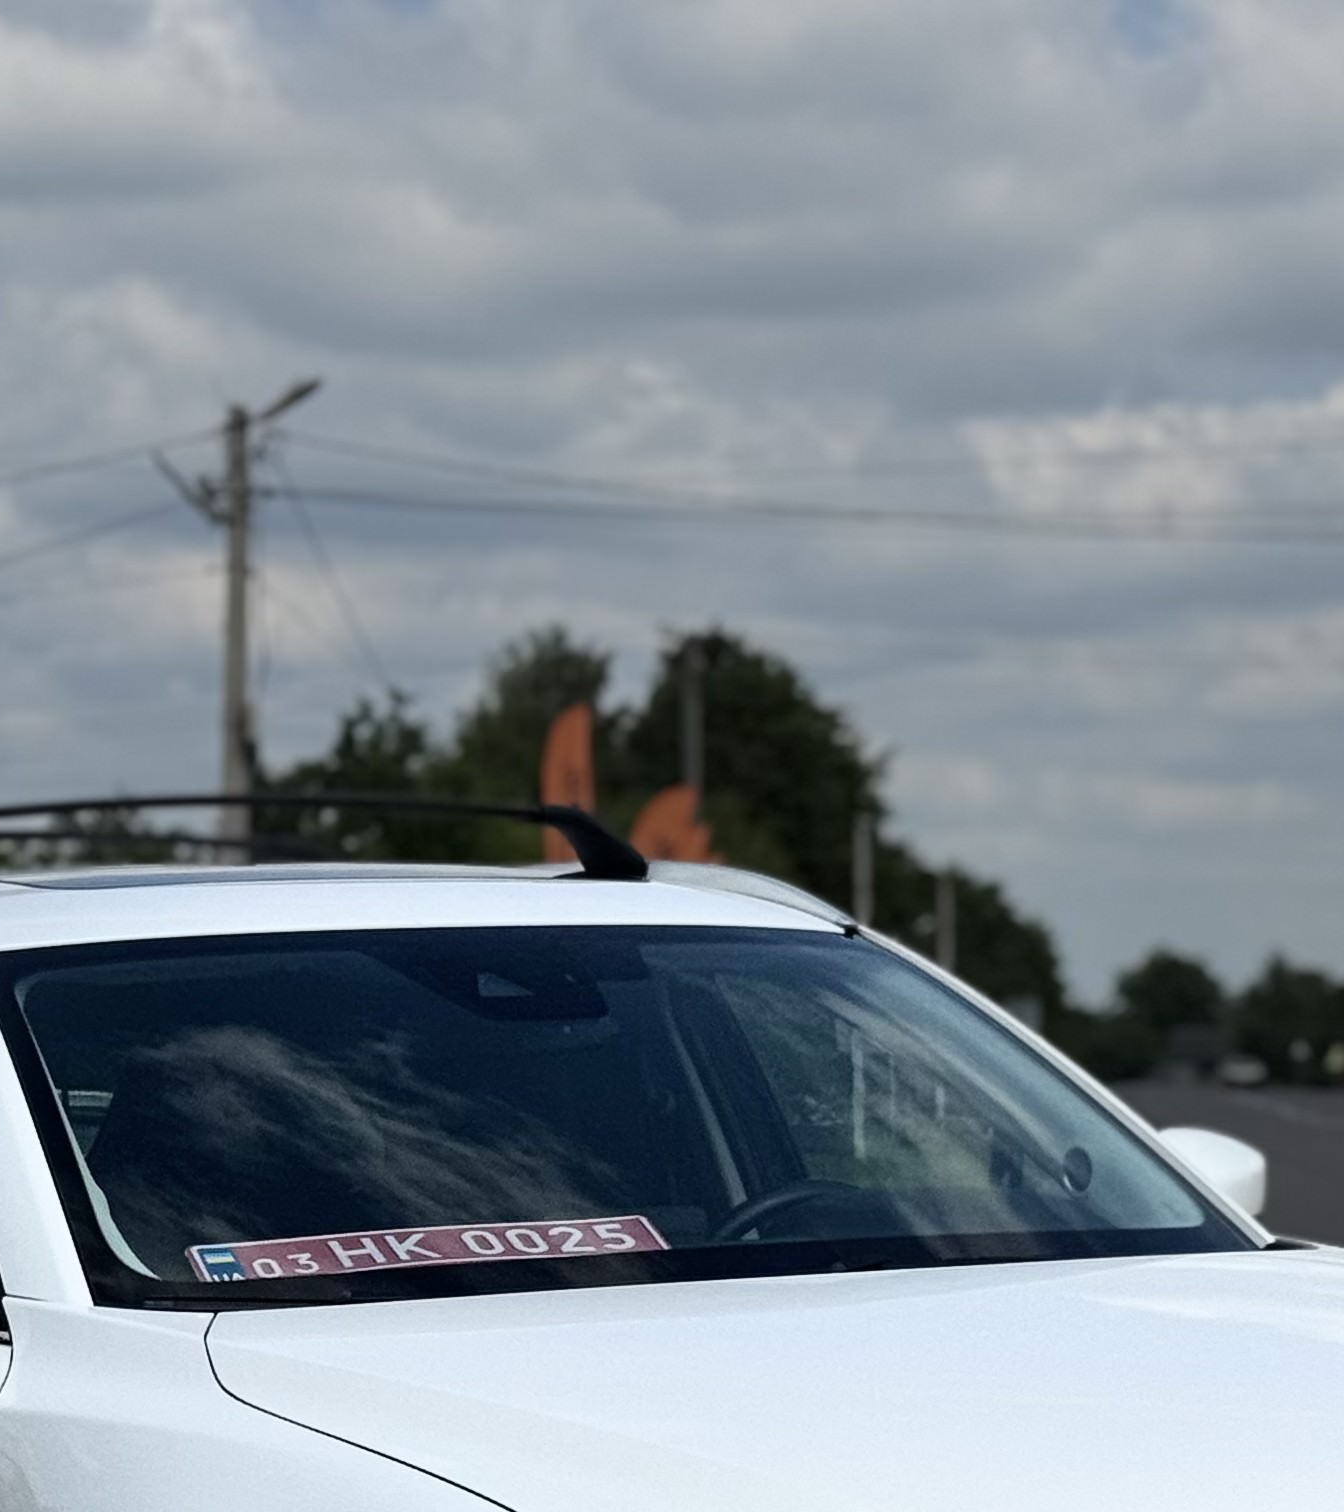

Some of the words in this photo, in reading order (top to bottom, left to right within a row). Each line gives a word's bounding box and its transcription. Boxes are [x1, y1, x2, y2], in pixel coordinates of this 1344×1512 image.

[251, 1252, 320, 1279] 03
[327, 1231, 441, 1269] HK
[460, 1223, 637, 1256] 0025
